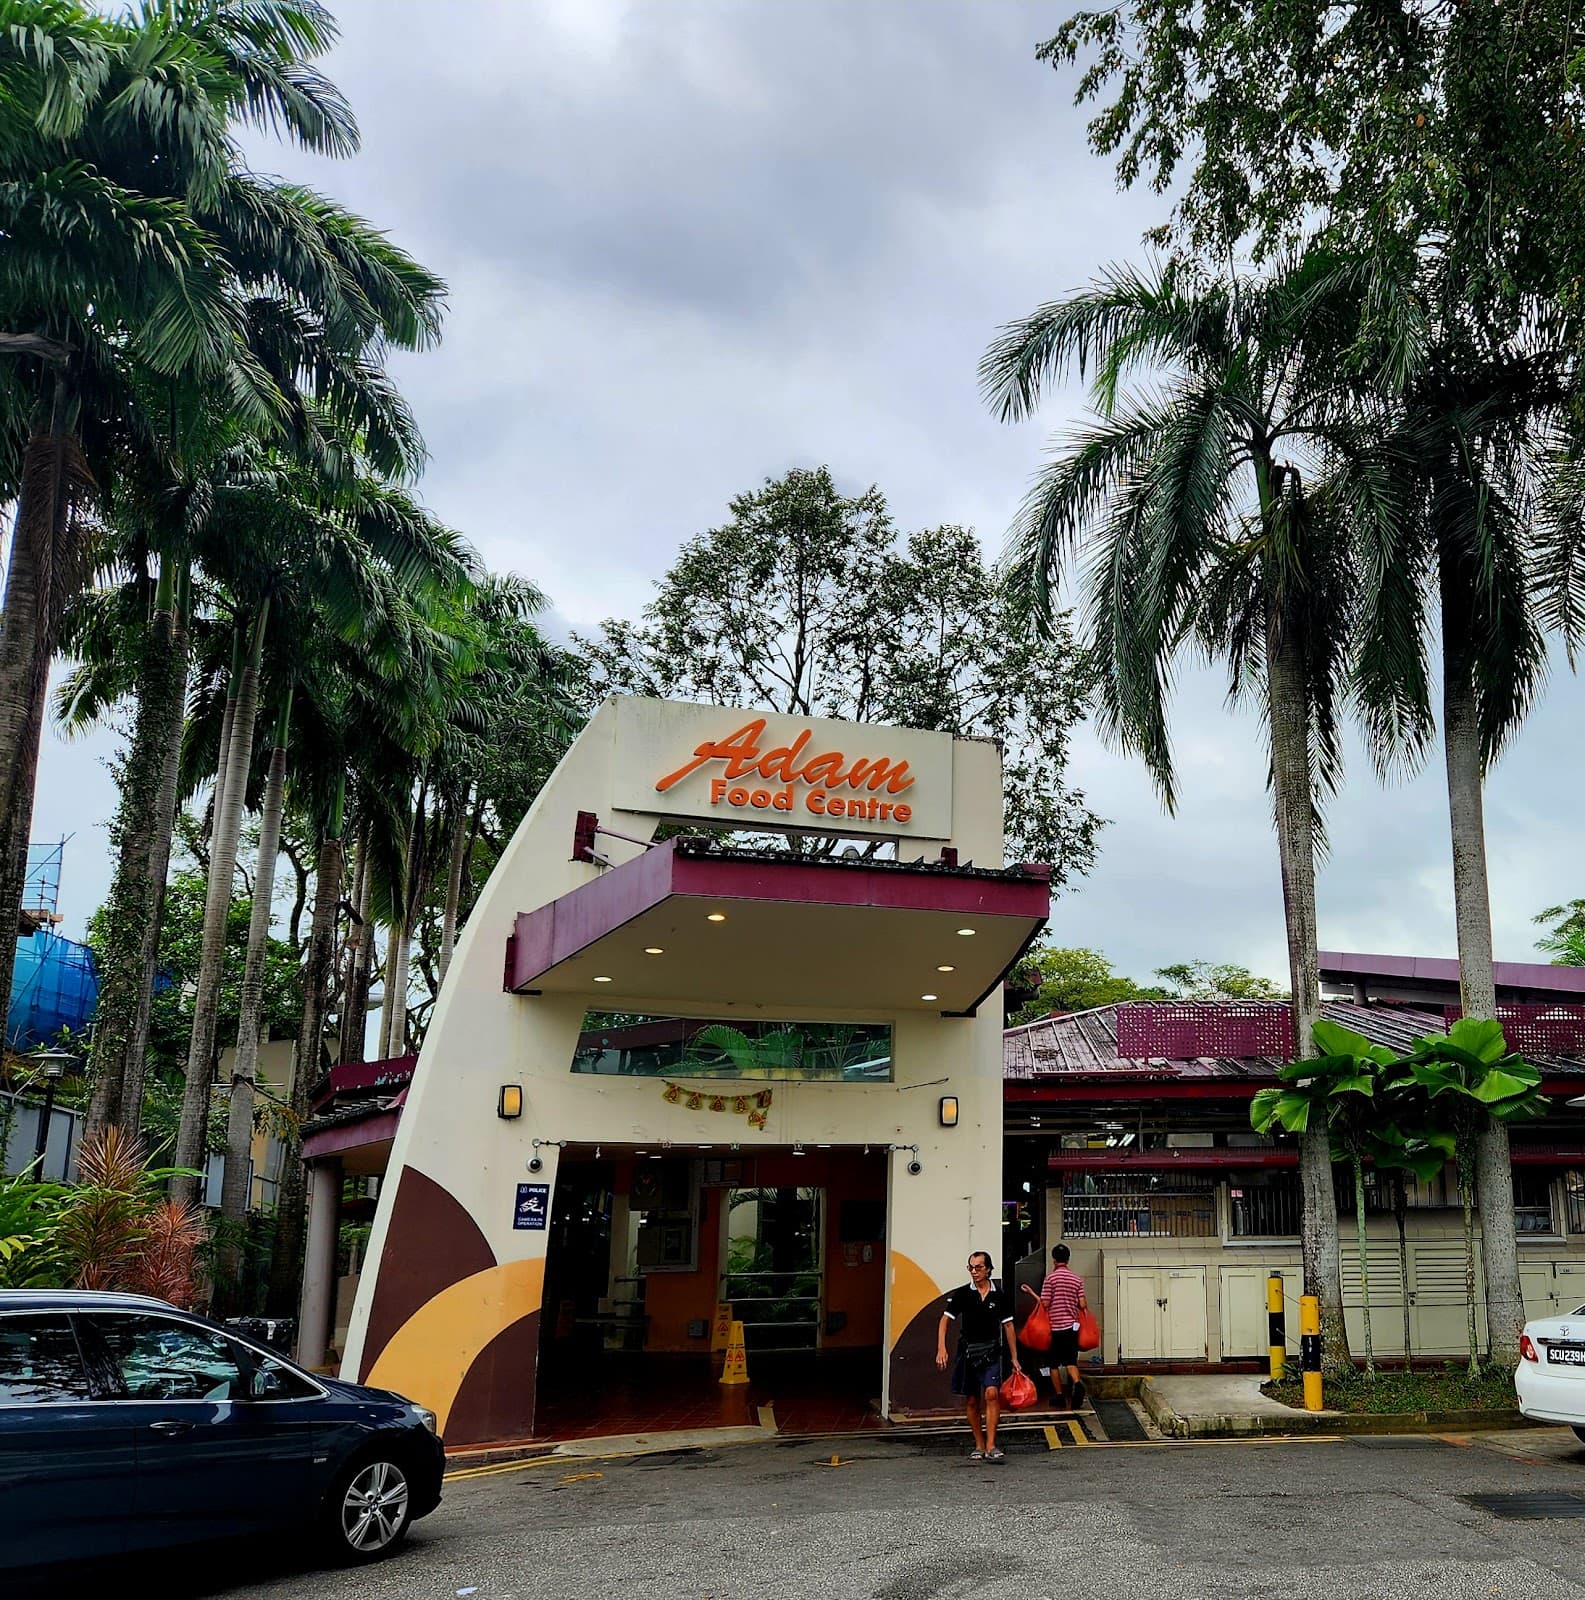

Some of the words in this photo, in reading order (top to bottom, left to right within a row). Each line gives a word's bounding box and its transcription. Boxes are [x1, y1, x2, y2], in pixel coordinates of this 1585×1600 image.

[656, 718, 915, 793] Adam
[711, 779, 794, 810] Food
[806, 789, 912, 822] Centre
